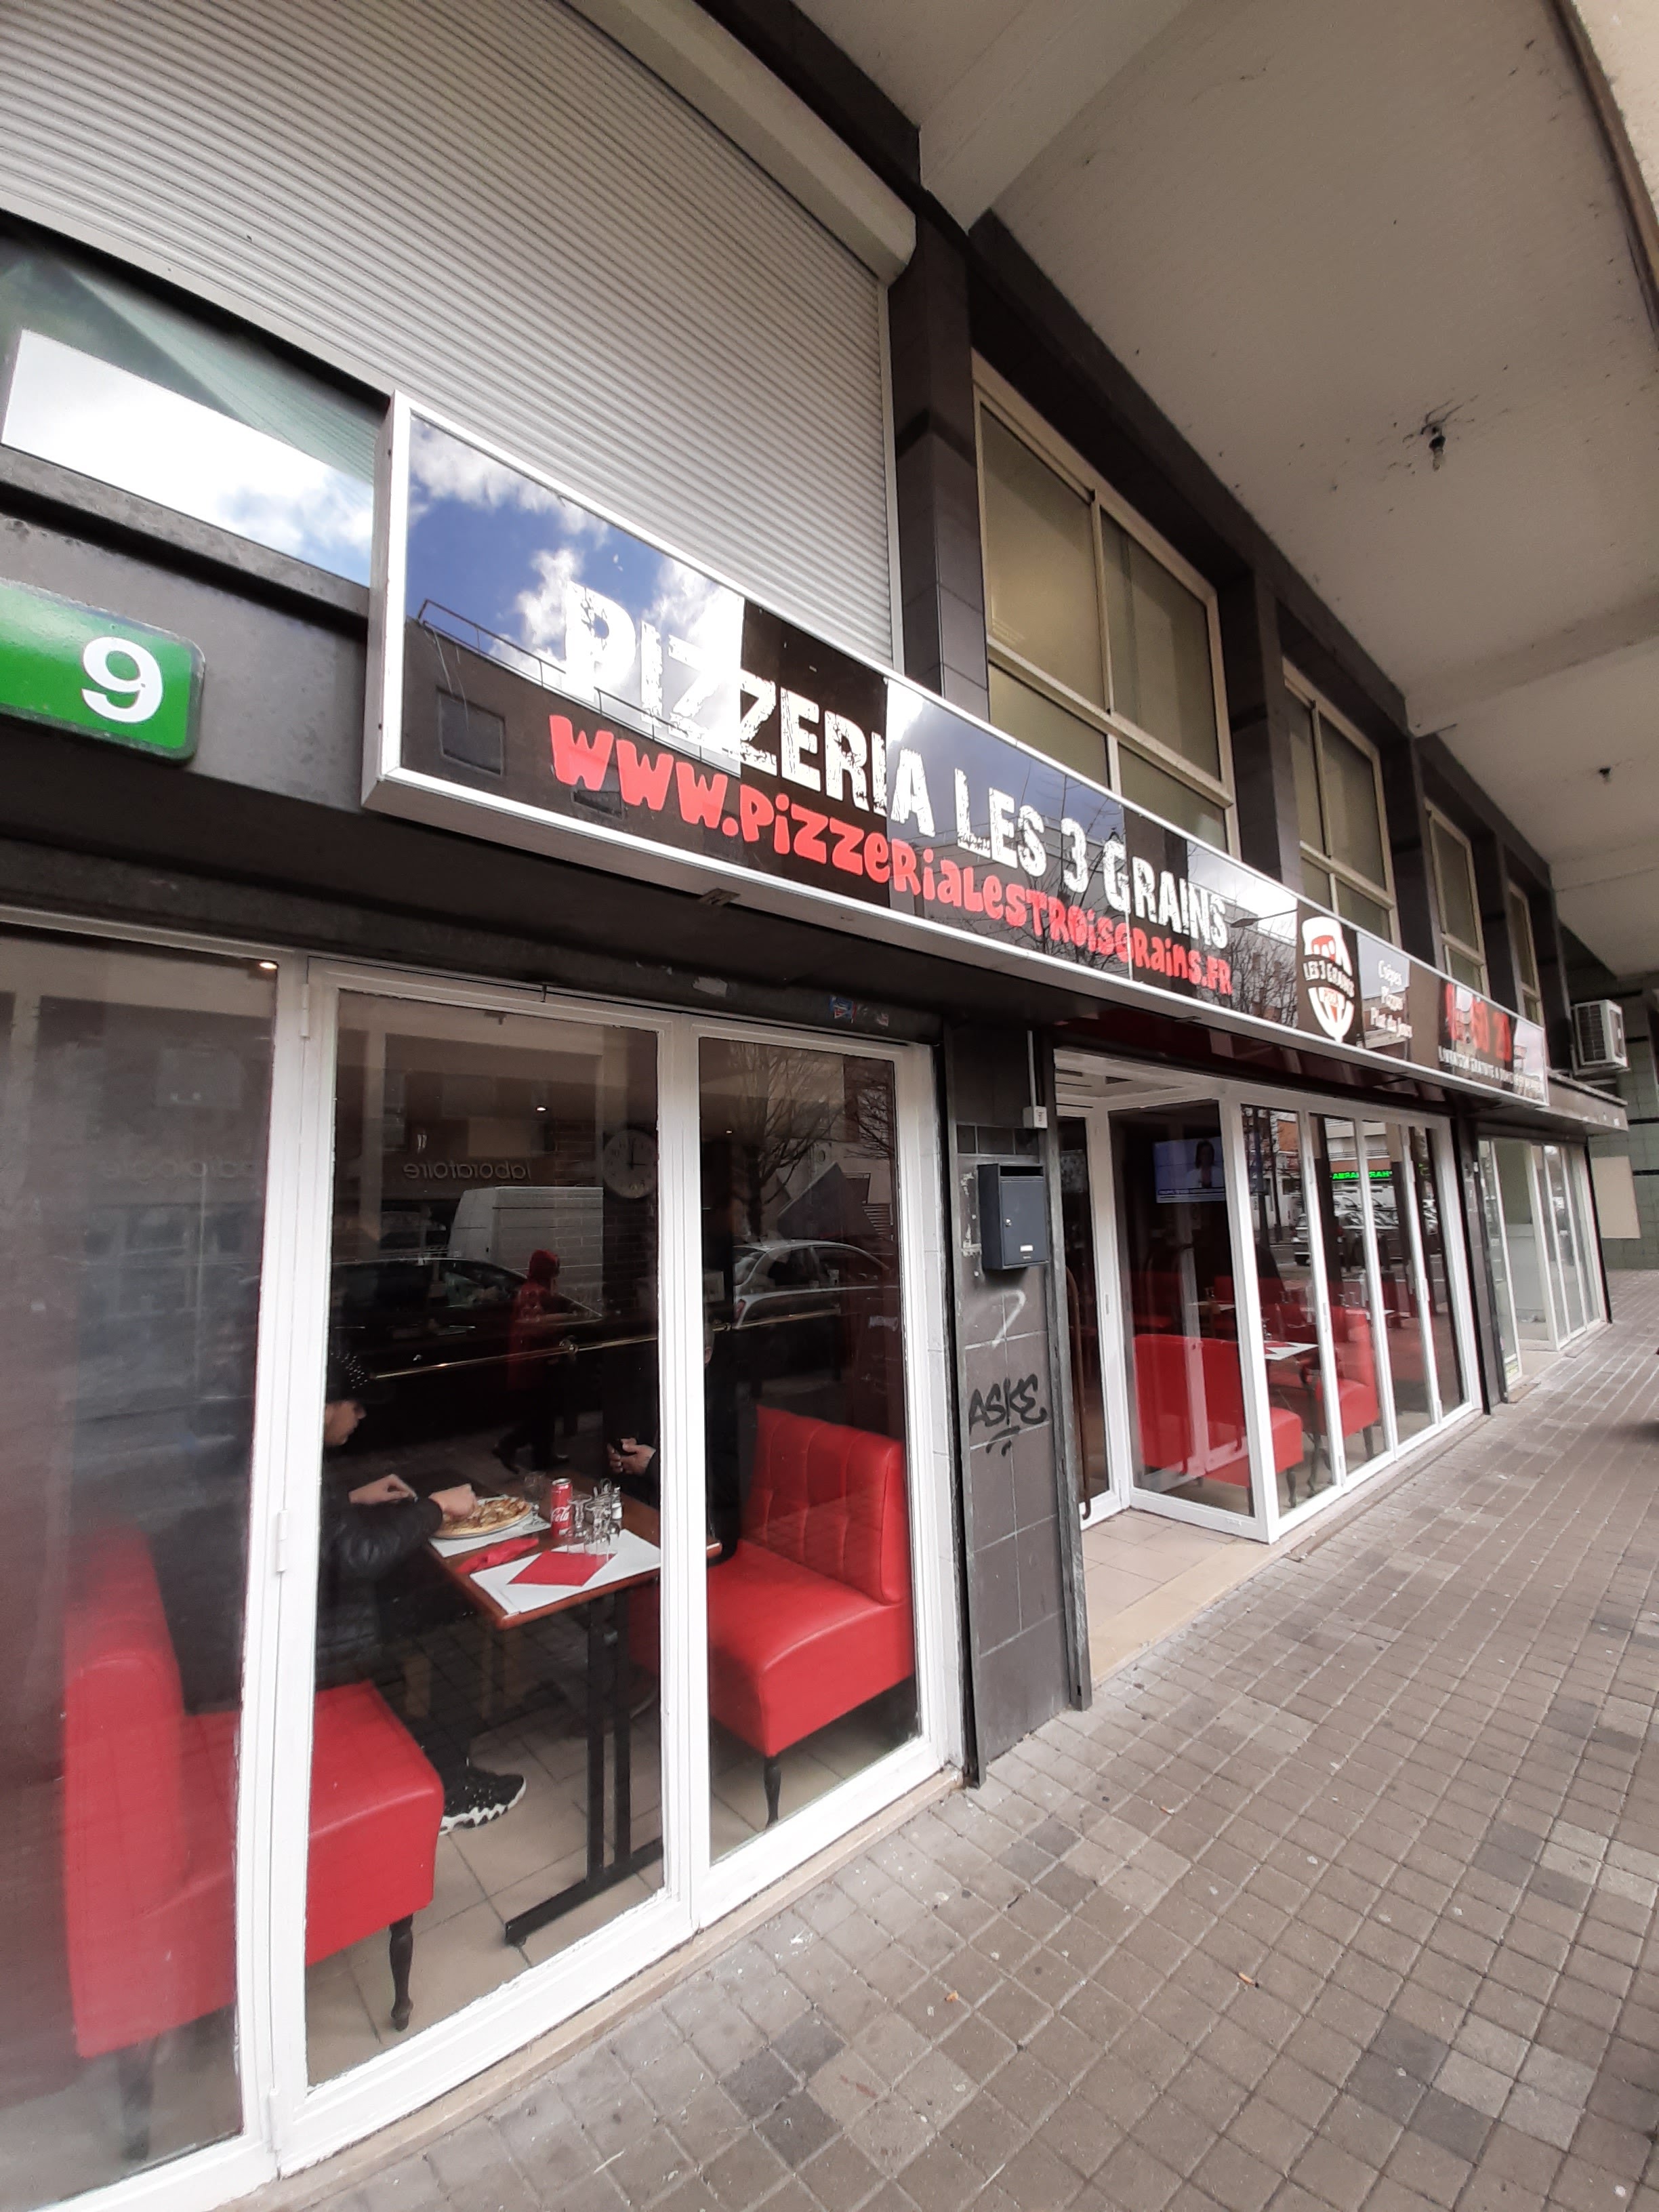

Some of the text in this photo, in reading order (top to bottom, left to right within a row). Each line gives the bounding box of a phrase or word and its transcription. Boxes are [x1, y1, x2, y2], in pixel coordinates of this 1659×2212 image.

[81, 636, 163, 723] 9
[564, 581, 1229, 949] PIZZERIA LES 3 GRAINS
